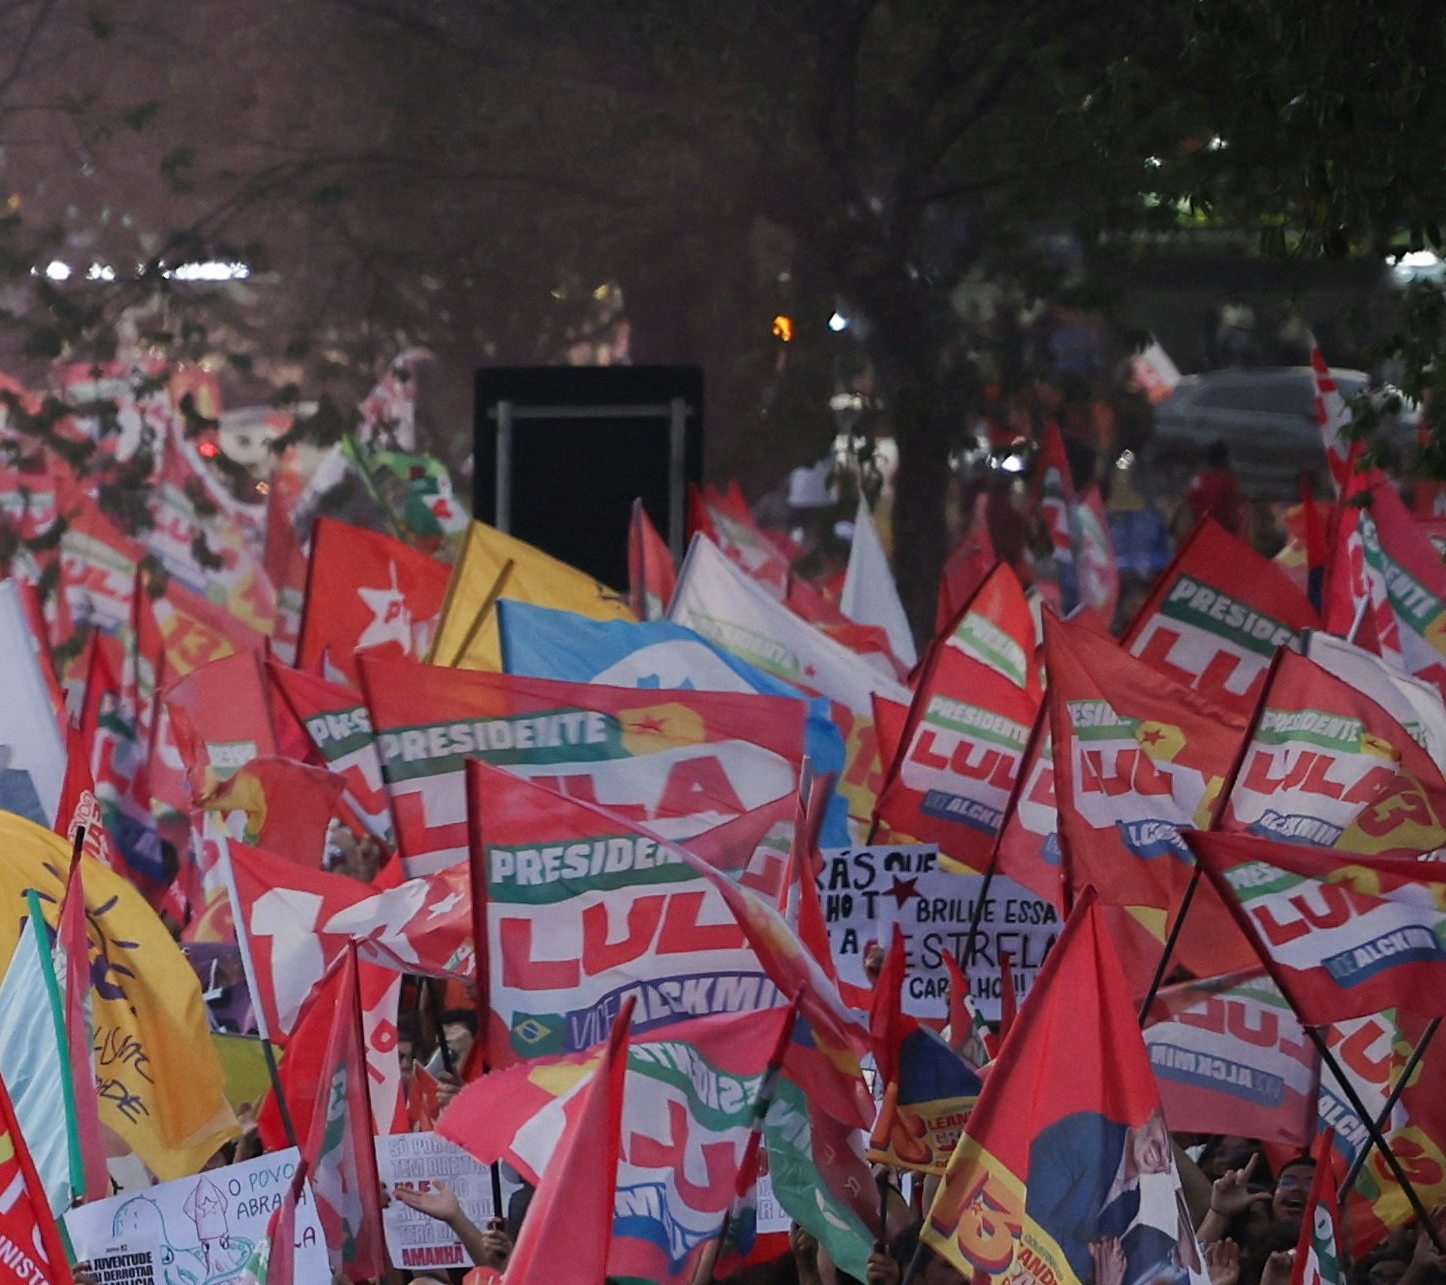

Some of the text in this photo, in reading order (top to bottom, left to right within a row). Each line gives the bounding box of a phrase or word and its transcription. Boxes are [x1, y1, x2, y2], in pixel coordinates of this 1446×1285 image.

[379, 711, 608, 765] PRESIDENTE
[1005, 898, 1058, 925] ESSA
[499, 890, 750, 991] LUL
[228, 1162, 295, 1197] O POVO
[237, 1188, 307, 1221] ABRAA
[92, 1251, 153, 1274] JUVENTUDE
[102, 1265, 154, 1283] DERROTAR
